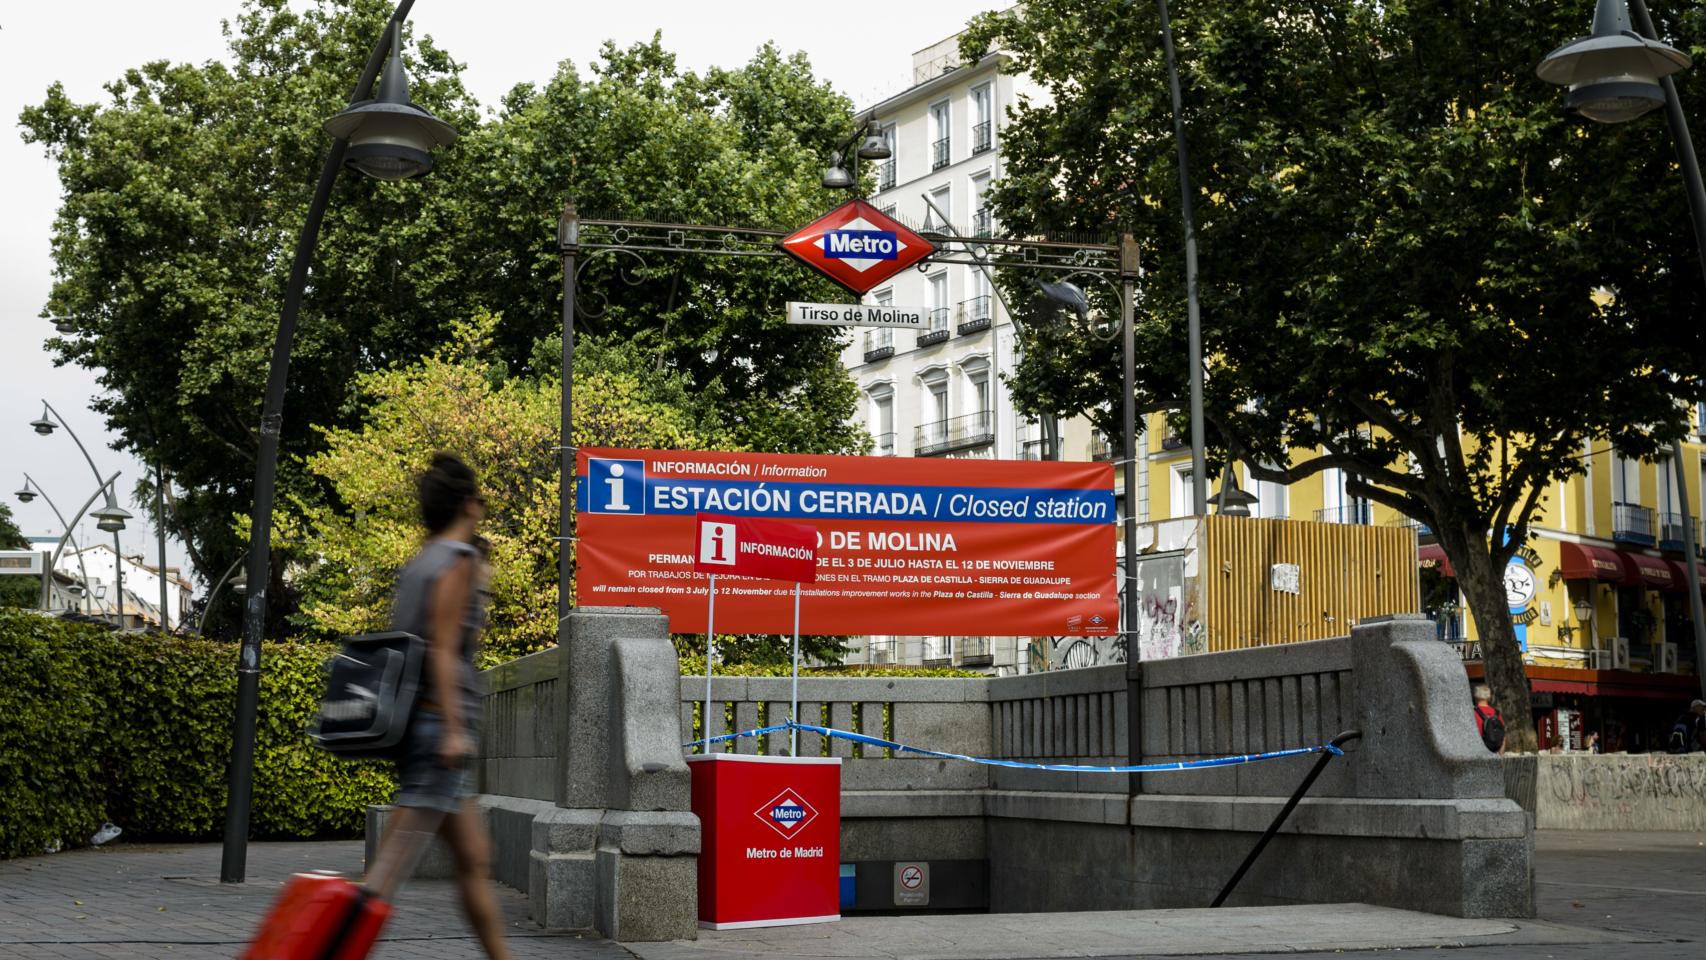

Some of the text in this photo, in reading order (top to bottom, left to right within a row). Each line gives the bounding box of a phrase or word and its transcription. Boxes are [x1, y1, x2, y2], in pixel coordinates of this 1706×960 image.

[830, 233, 893, 254] Metro
[799, 306, 920, 324] Tirso de Molina
[653, 460, 827, 478] INFORMACIÓN / Information
[654, 482, 1107, 519] ESTACIÓN CERRADA / Closed station
[830, 531, 861, 550] DE
[868, 532, 957, 552] MOLINA
[740, 541, 813, 561] INFORMACIÓN
[648, 554, 696, 564] PERMAN
[832, 558, 845, 567] EL
[848, 559, 854, 567] 3
[857, 558, 871, 568] DE
[874, 559, 905, 569] JULIO
[908, 559, 943, 569] HASTA
[945, 560, 959, 569] EL
[961, 560, 973, 570] 12
[976, 560, 991, 570] DE
[993, 561, 1055, 571] NOVIEMBRE
[628, 570, 646, 579] POR
[648, 571, 691, 579] TRABAJOS
[693, 572, 705, 580] DE
[838, 574, 849, 582] EN
[863, 575, 890, 583] TRAMO
[892, 575, 918, 584] PLAZA
[921, 576, 932, 584] DE
[935, 576, 973, 584] CASTILLA
[979, 577, 1008, 585] SIERRA
[1010, 577, 1021, 585] DE
[1023, 577, 1071, 585] GUADALUPE
[592, 585, 606, 593] will
[637, 586, 664, 594] closed
[666, 586, 684, 594] from
[693, 587, 709, 596] July
[732, 588, 772, 596] November
[773, 588, 787, 596] due
[799, 588, 840, 597] nstallations
[841, 589, 889, 599] improvement
[889, 589, 910, 598] works
[912, 590, 919, 598] in
[920, 590, 932, 598] the
[933, 590, 953, 599] Plaza
[955, 590, 964, 599] de
[966, 591, 993, 599] Castilla
[1000, 591, 1021, 599] Sierra
[1034, 592, 1073, 601] Guadalupe
[1075, 592, 1100, 600] section
[775, 808, 802, 819] Metro
[746, 846, 824, 859] Metro de Madrid
